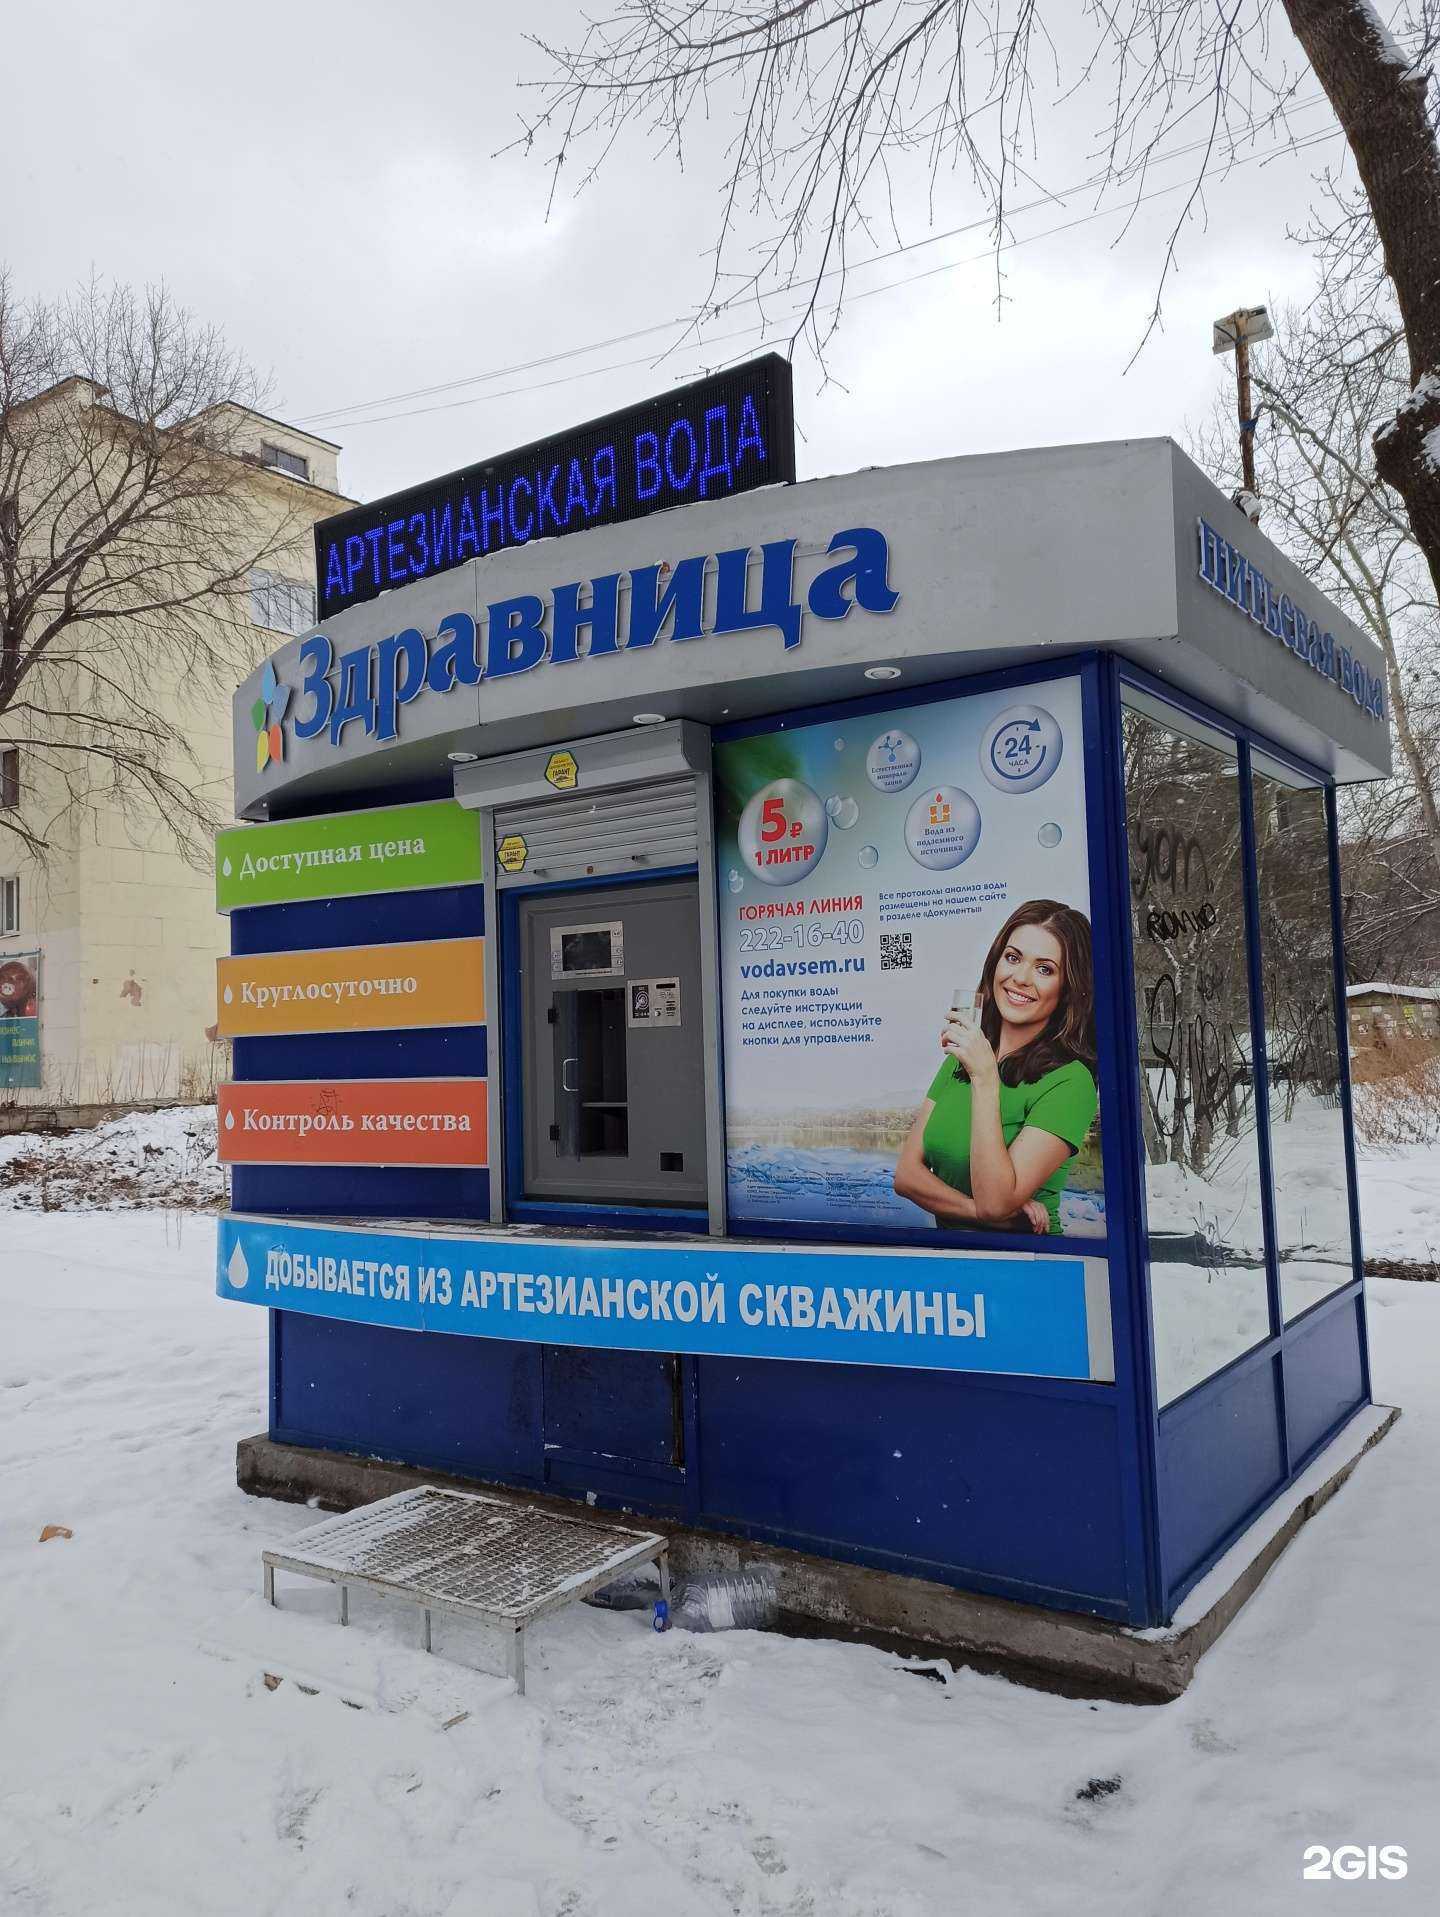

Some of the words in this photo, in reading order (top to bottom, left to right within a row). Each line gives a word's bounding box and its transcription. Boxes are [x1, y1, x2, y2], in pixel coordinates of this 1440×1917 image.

[323, 443, 618, 601] АРТЕЗИАНСКАЯ
[635, 394, 768, 500] ВОДА
[293, 525, 902, 748] Здравница
[1004, 734, 1033, 759] 24
[1008, 758, 1030, 768] ЧАСА
[916, 834, 965, 848] подземного
[924, 827, 945, 837] Вода
[946, 826, 956, 834] из
[239, 844, 363, 881] Доступная
[368, 837, 427, 863] цена
[755, 850, 763, 866] 1
[766, 845, 815, 866] ЛИТР
[920, 845, 964, 856] источника
[879, 891, 895, 901] Все
[896, 889, 943, 901] протоколы
[944, 884, 982, 894] анализа
[983, 881, 1008, 892] воды
[739, 900, 805, 920] ГОРЯЧАЯ
[809, 895, 863, 914] ЛИНИЯ
[879, 901, 931, 913] размещены
[932, 899, 944, 907] на
[945, 896, 977, 904] нашем
[979, 891, 1007, 901] сайте
[886, 911, 922, 922] разделе
[739, 919, 864, 952] 222-16-40
[740, 957, 866, 979] vodavsem.ru
[241, 976, 418, 1007] Круглосуточно
[741, 989, 760, 1001] Для
[763, 987, 807, 999] покупки
[809, 986, 839, 997] воды
[741, 1003, 792, 1016] следуйте
[795, 1001, 863, 1014] инструкции
[742, 1021, 755, 1030] на
[757, 1019, 807, 1030] дисплее,
[810, 1013, 882, 1029] используйте
[742, 1036, 779, 1046] кнопки
[781, 1035, 801, 1046] для
[803, 1032, 874, 1046] управления.
[243, 1108, 355, 1137] Контроль
[360, 1113, 472, 1133] качества
[264, 1250, 411, 1302] ДОБЫВАЕТСЯ
[418, 1266, 453, 1307] ИЗ
[459, 1271, 727, 1325] АРТЕЗИАНСКОЙ
[738, 1283, 987, 1339] СКВАЖИНЫ
